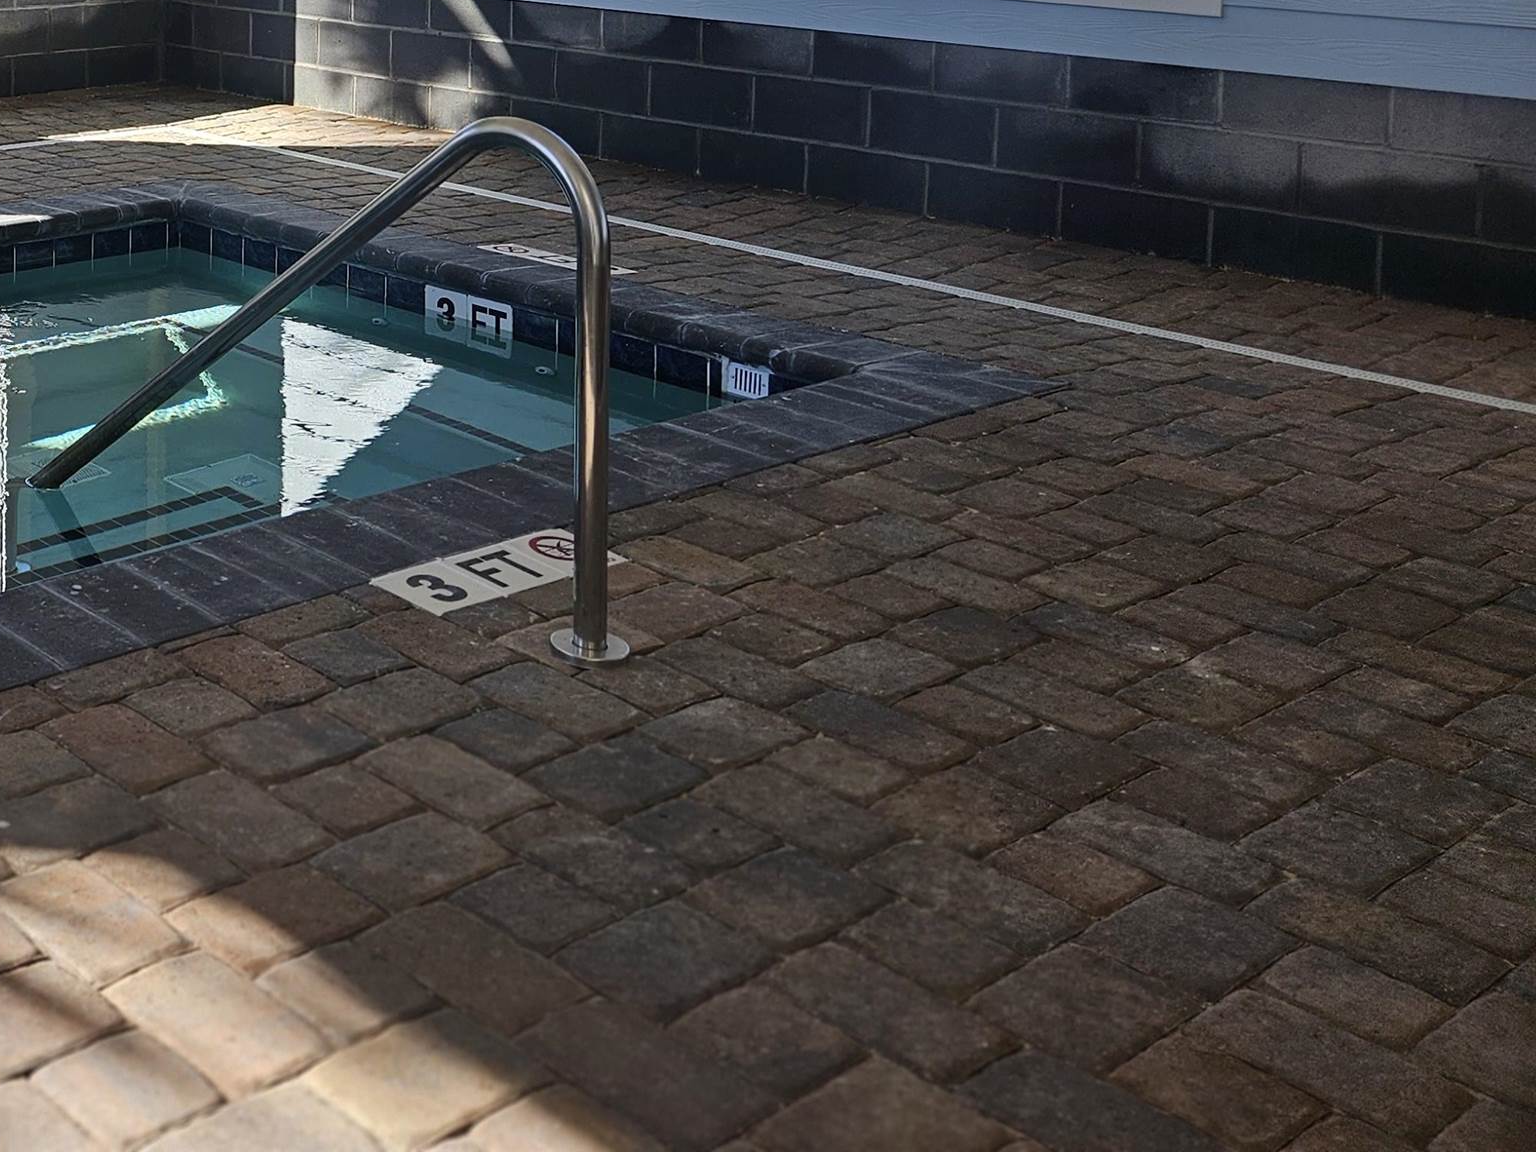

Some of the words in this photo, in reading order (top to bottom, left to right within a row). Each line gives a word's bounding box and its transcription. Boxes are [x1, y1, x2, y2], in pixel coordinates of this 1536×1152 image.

[437, 297, 456, 322] 3
[471, 303, 508, 335] FT
[405, 574, 468, 602] 3
[455, 549, 544, 588] FT
